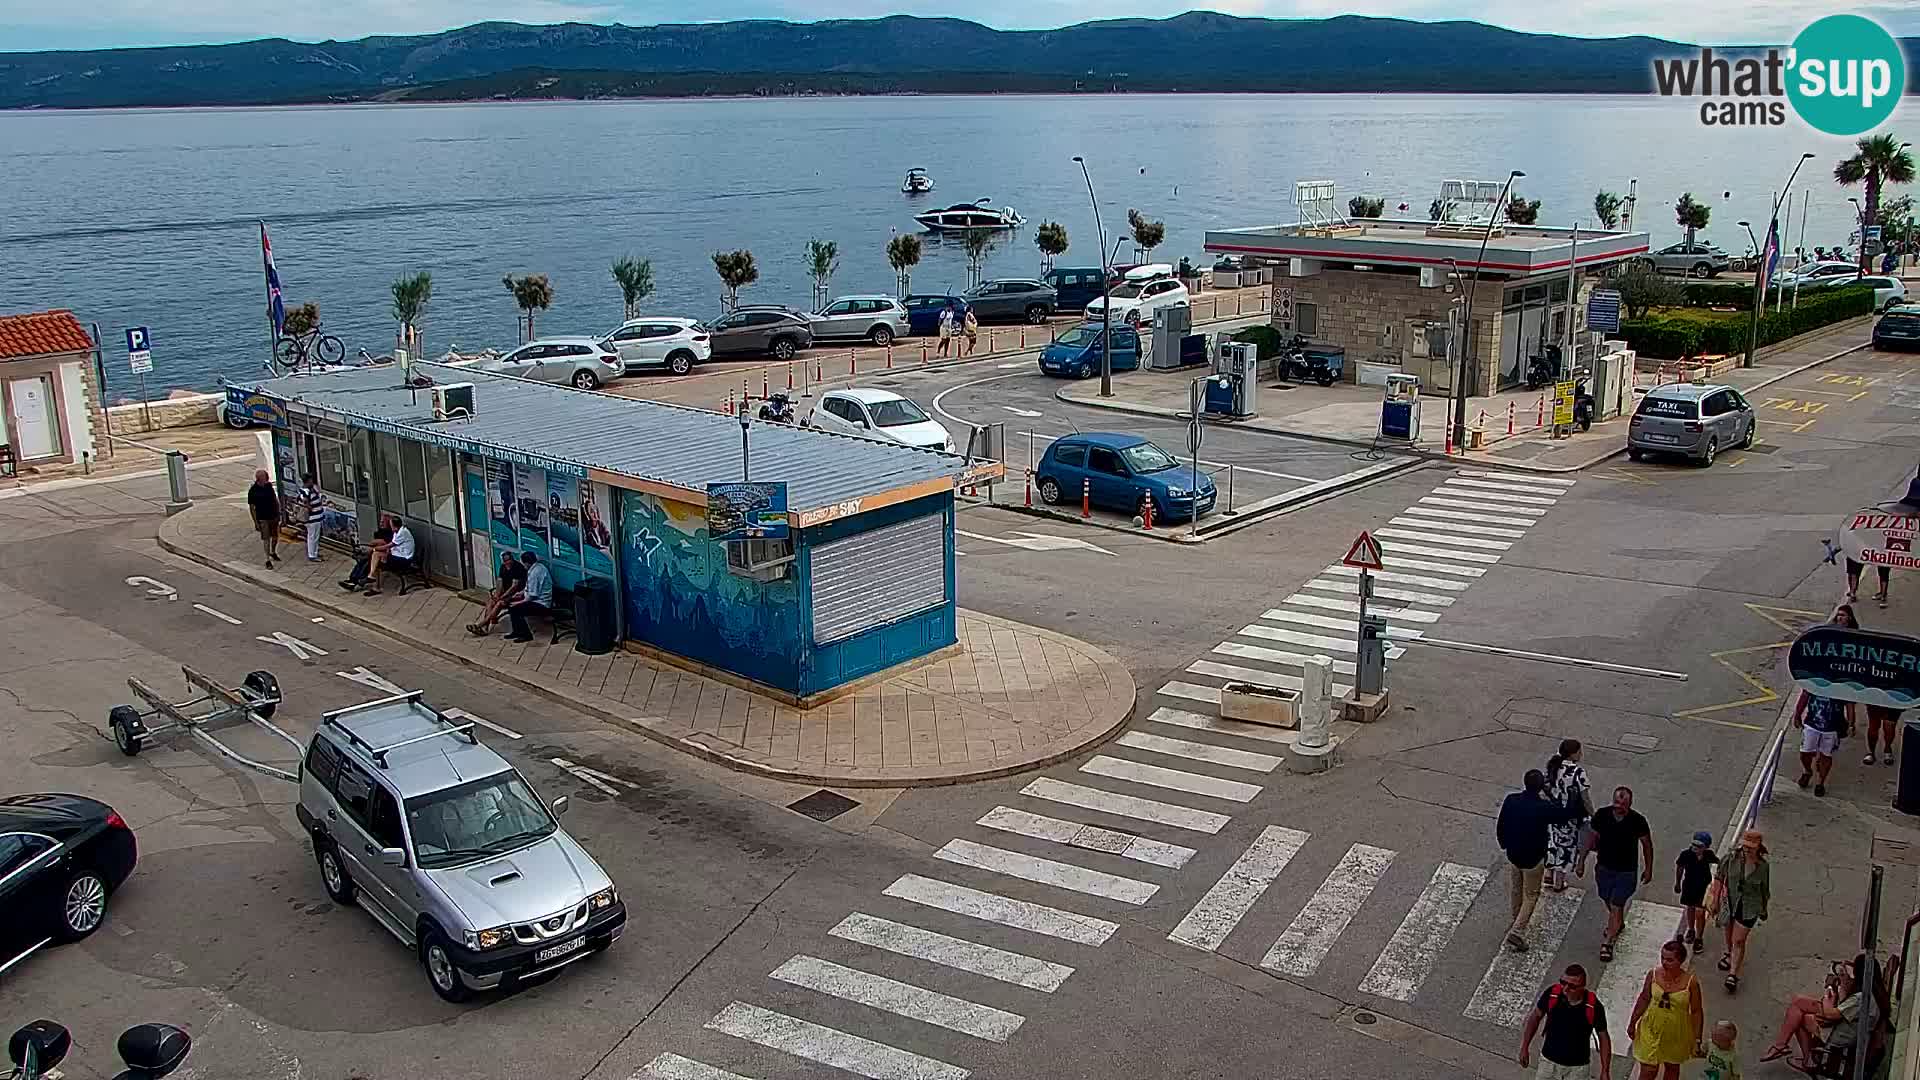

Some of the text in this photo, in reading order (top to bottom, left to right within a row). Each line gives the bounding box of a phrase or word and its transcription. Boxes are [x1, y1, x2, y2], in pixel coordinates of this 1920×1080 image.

[131, 330, 143, 349] P
[1815, 372, 1881, 388] TAXI
[1657, 401, 1678, 410] TAXI
[1760, 397, 1829, 414] TAXI
[437, 435, 469, 451] POSTAJA
[479, 443, 494, 457] BUS
[495, 448, 527, 464] STATION
[529, 456, 555, 471] TICKET
[556, 463, 583, 476] OFFICE
[1849, 514, 1920, 532] PIZZE
[1883, 529, 1917, 540] GRILL
[1800, 641, 1920, 672] MARINER
[1871, 664, 1897, 679] bar
